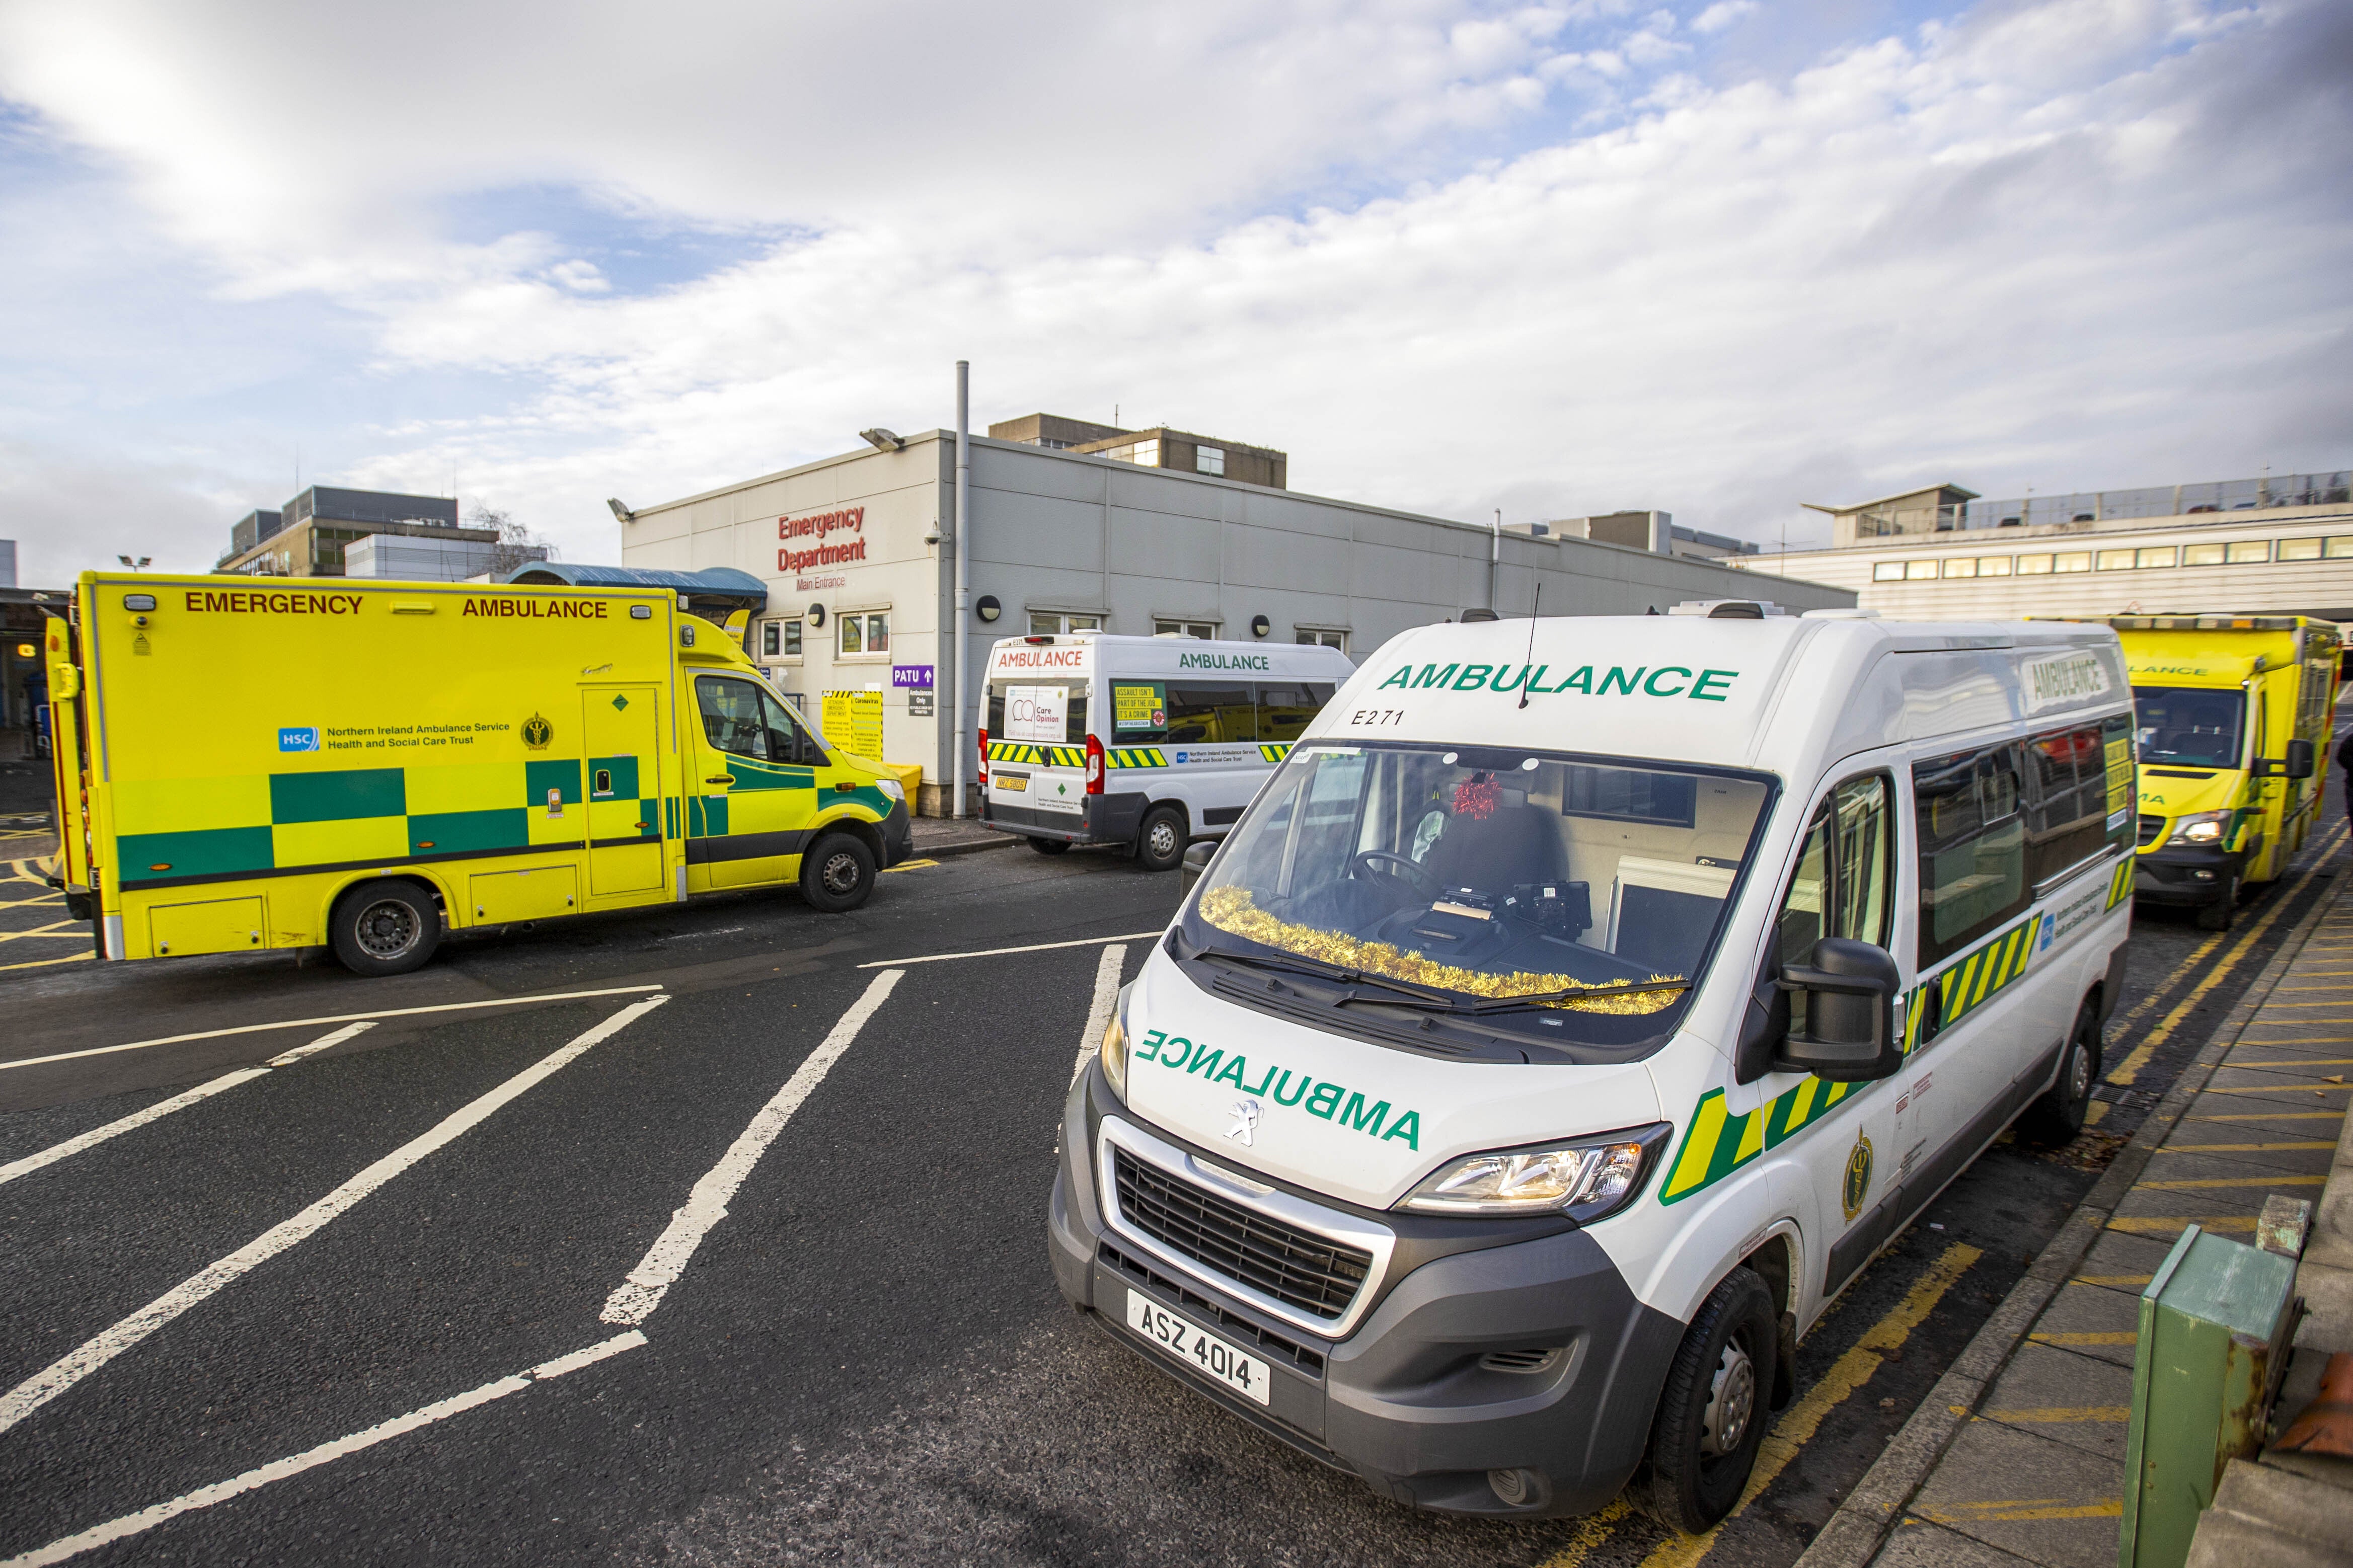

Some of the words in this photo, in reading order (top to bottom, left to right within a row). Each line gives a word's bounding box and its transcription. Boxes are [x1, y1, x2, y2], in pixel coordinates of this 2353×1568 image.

[779, 506, 864, 539] Emergency
[778, 535, 866, 574] Department
[797, 579, 812, 591] Main
[814, 576, 845, 588] Entrance
[185, 591, 363, 614] EMERGENCY
[462, 598, 608, 618] AMBULANCE
[998, 650, 1082, 667] AMBULANCE
[1179, 653, 1269, 670] AMBULANCE
[894, 670, 919, 682] PATU
[2128, 665, 2209, 676] LANCE
[1378, 662, 1739, 702] AMBULANCE
[2032, 659, 2101, 700] AMBULANCE
[1036, 715, 1059, 723] Opinion
[1350, 710, 1404, 726] E271
[328, 728, 374, 736] Northern
[377, 726, 413, 735] Ireland
[416, 724, 472, 733] Ambulance
[474, 722, 510, 732] Service
[283, 734, 311, 744] HSC
[328, 740, 362, 749] Health
[365, 739, 385, 748] and
[389, 737, 419, 747] Social
[423, 737, 446, 745] Care
[449, 736, 474, 744] Trust
[998, 778, 1008, 788] NRZ
[1010, 779, 1024, 789] 5805
[1142, 1304, 1185, 1354] ASZ
[1194, 1336, 1251, 1389] 4014
